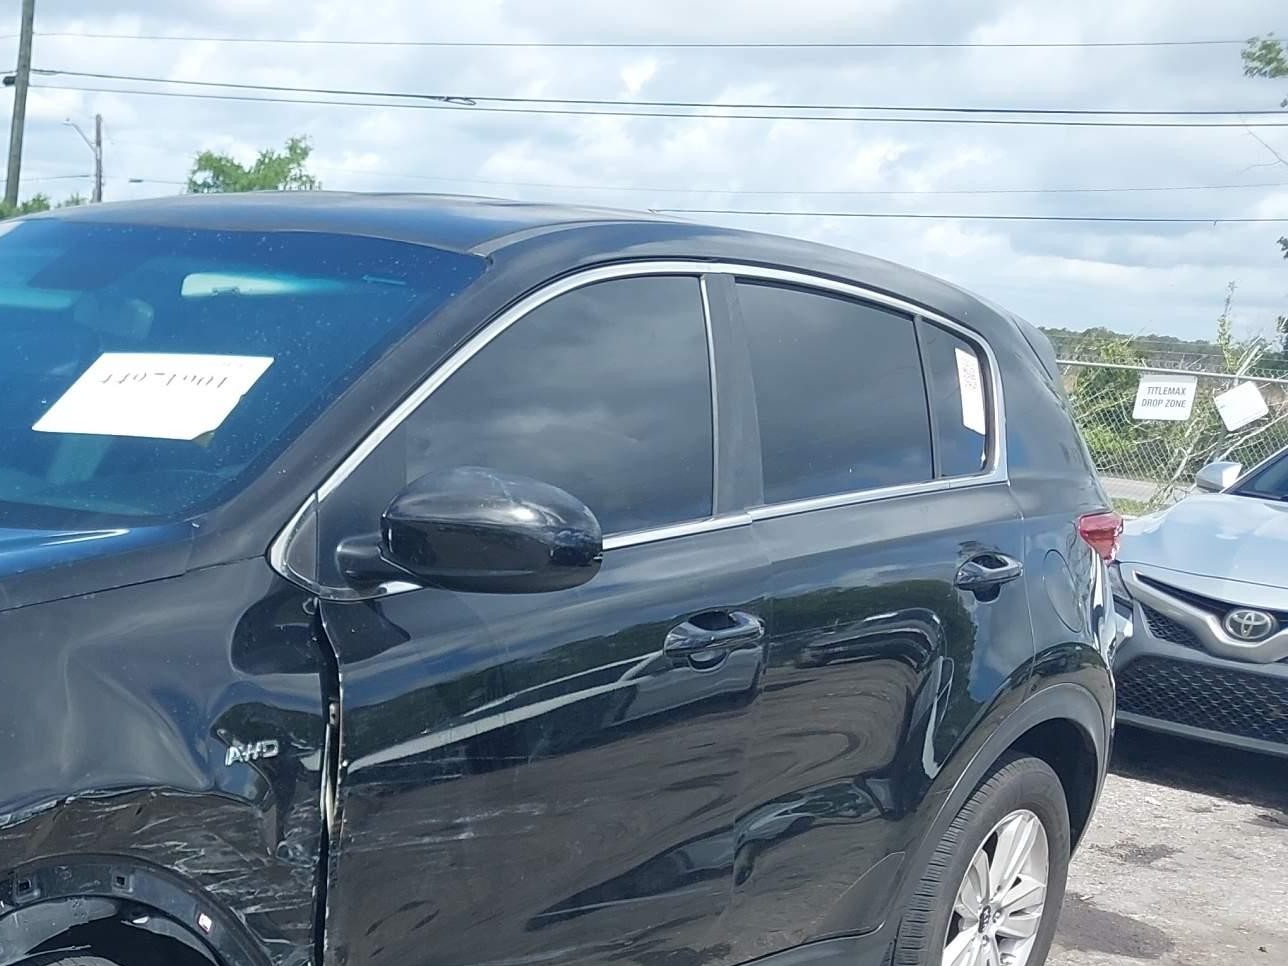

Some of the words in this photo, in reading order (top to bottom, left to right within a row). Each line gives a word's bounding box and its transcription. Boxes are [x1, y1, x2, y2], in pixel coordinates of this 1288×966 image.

[1147, 386, 1187, 395] TITLEMAX
[1141, 398, 1163, 408] DROP
[1165, 399, 1187, 408] ZONE
